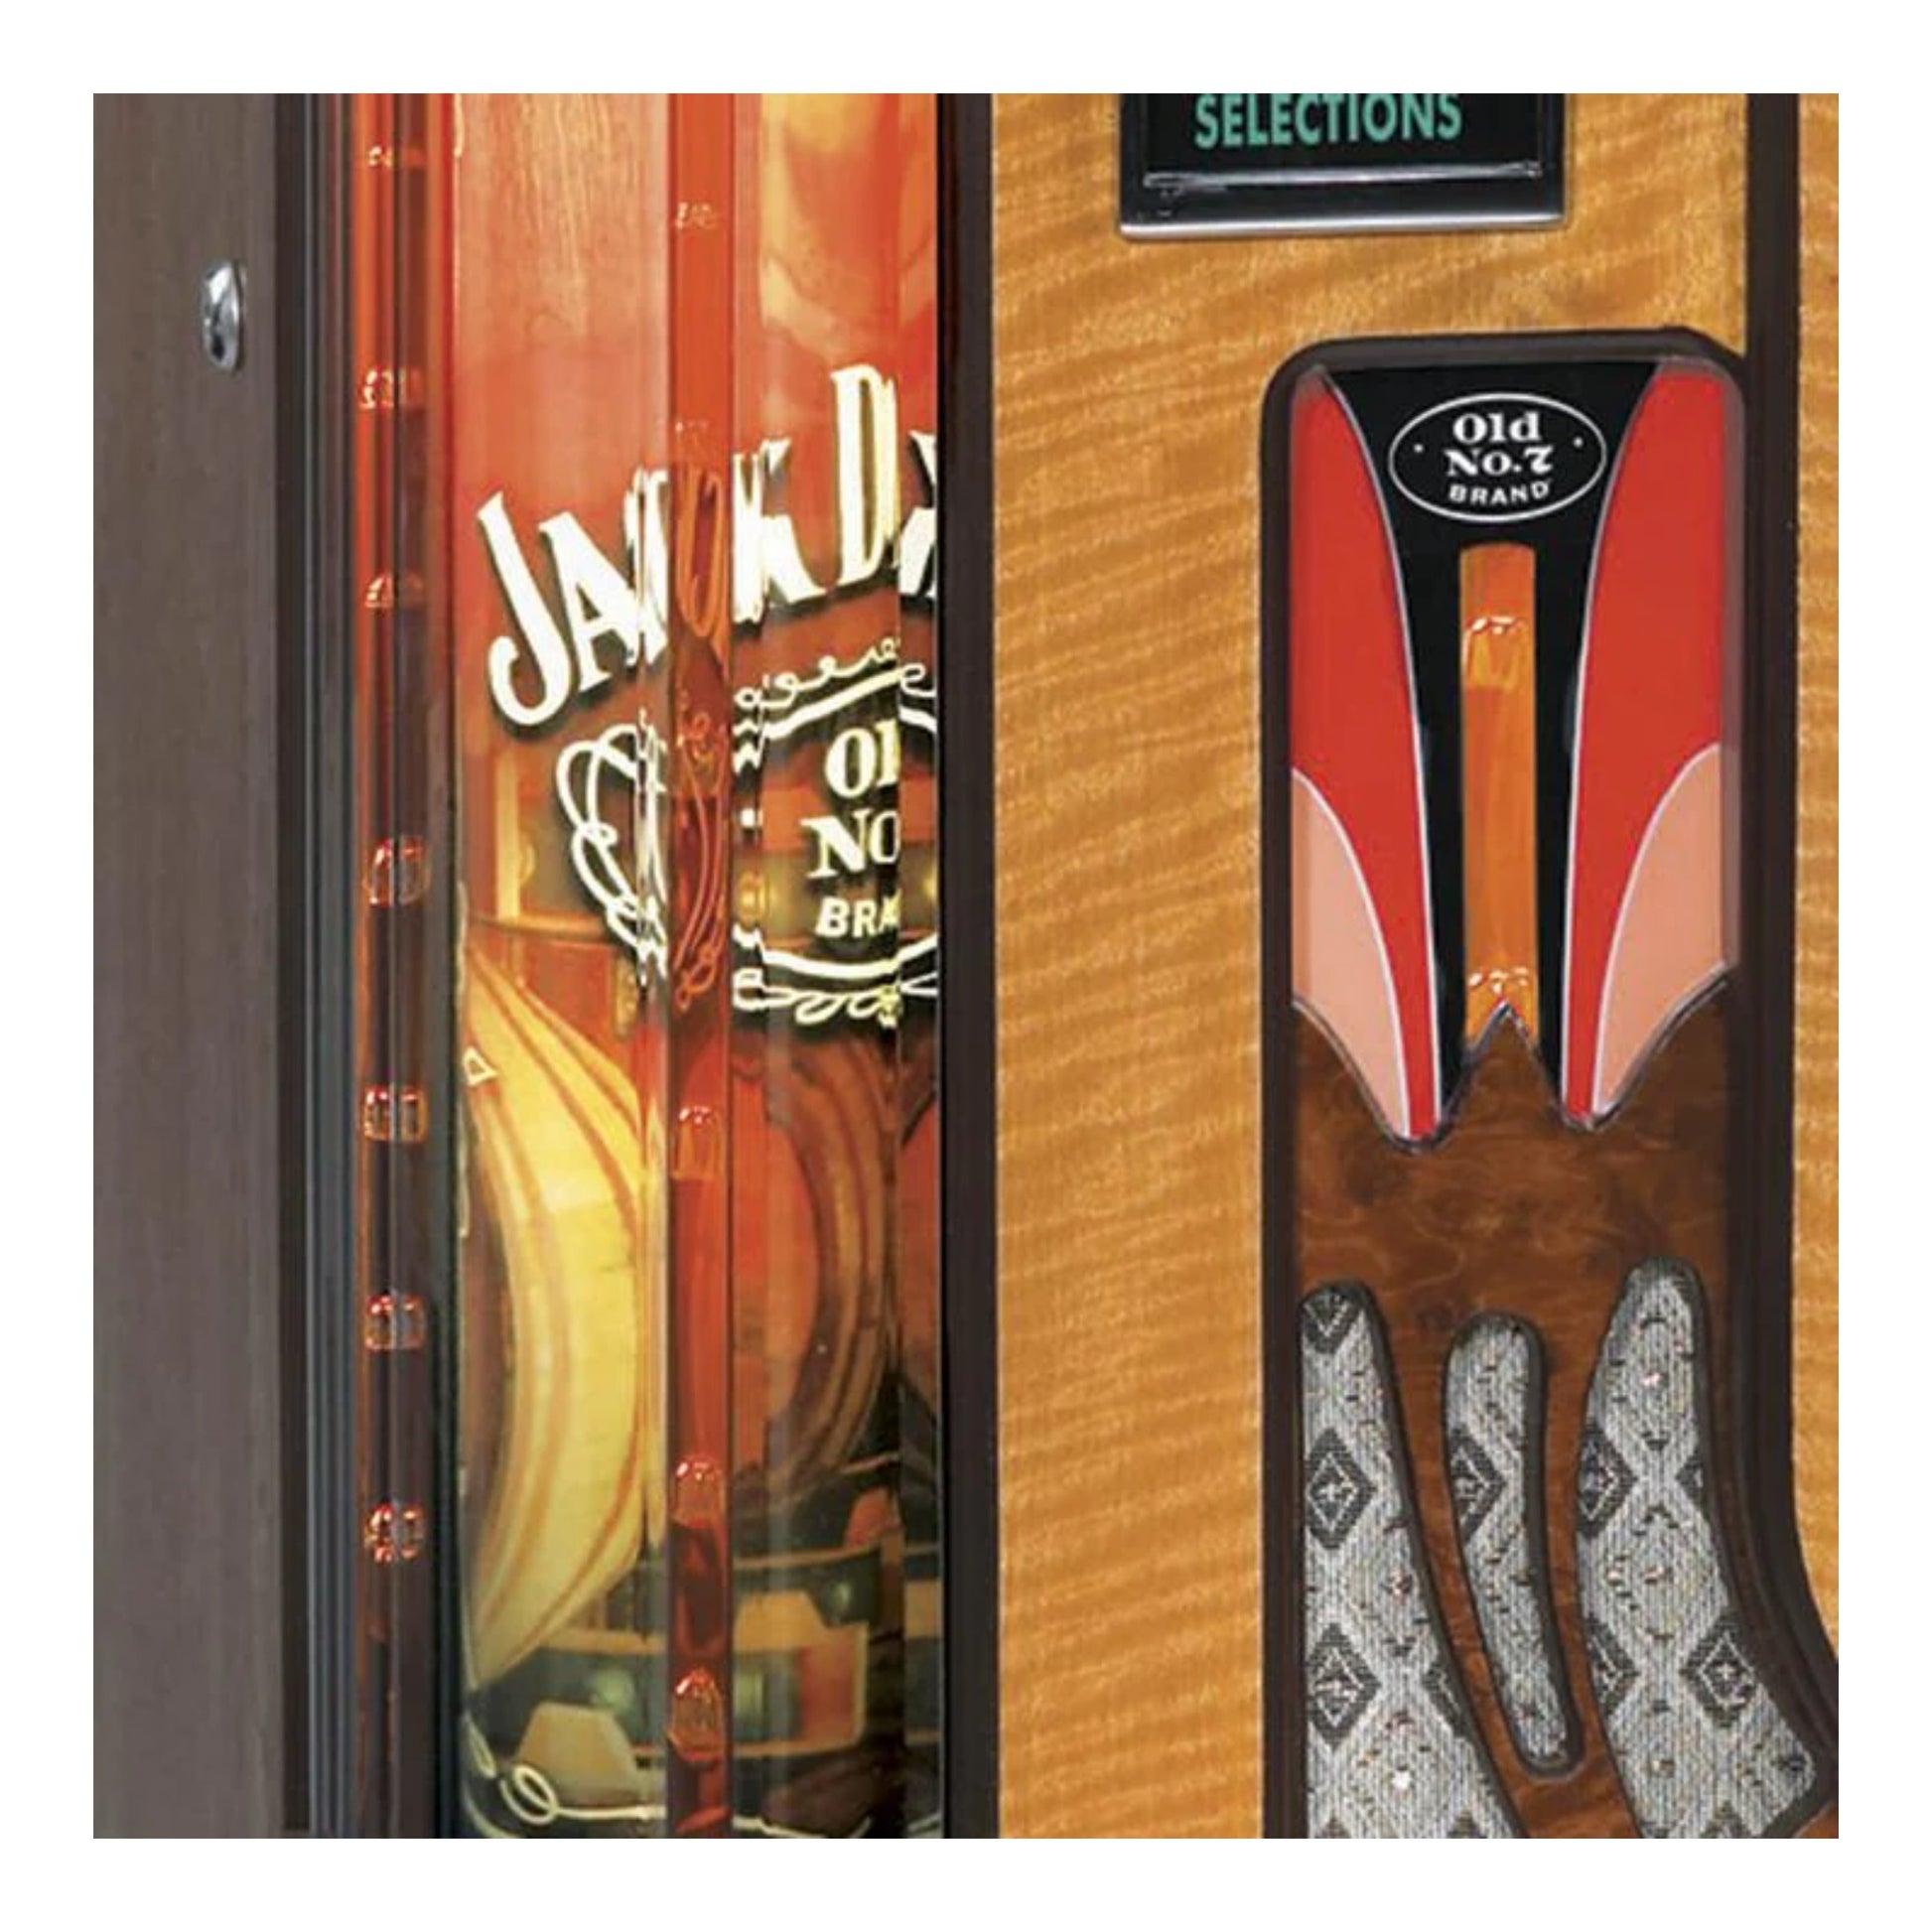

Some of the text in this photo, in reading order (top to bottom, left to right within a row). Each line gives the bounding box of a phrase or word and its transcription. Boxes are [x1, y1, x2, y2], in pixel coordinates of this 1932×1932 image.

[1194, 93, 1462, 149] SELECTIONS
[1452, 411, 1541, 445] Old
[1449, 480, 1552, 506] BRAND
